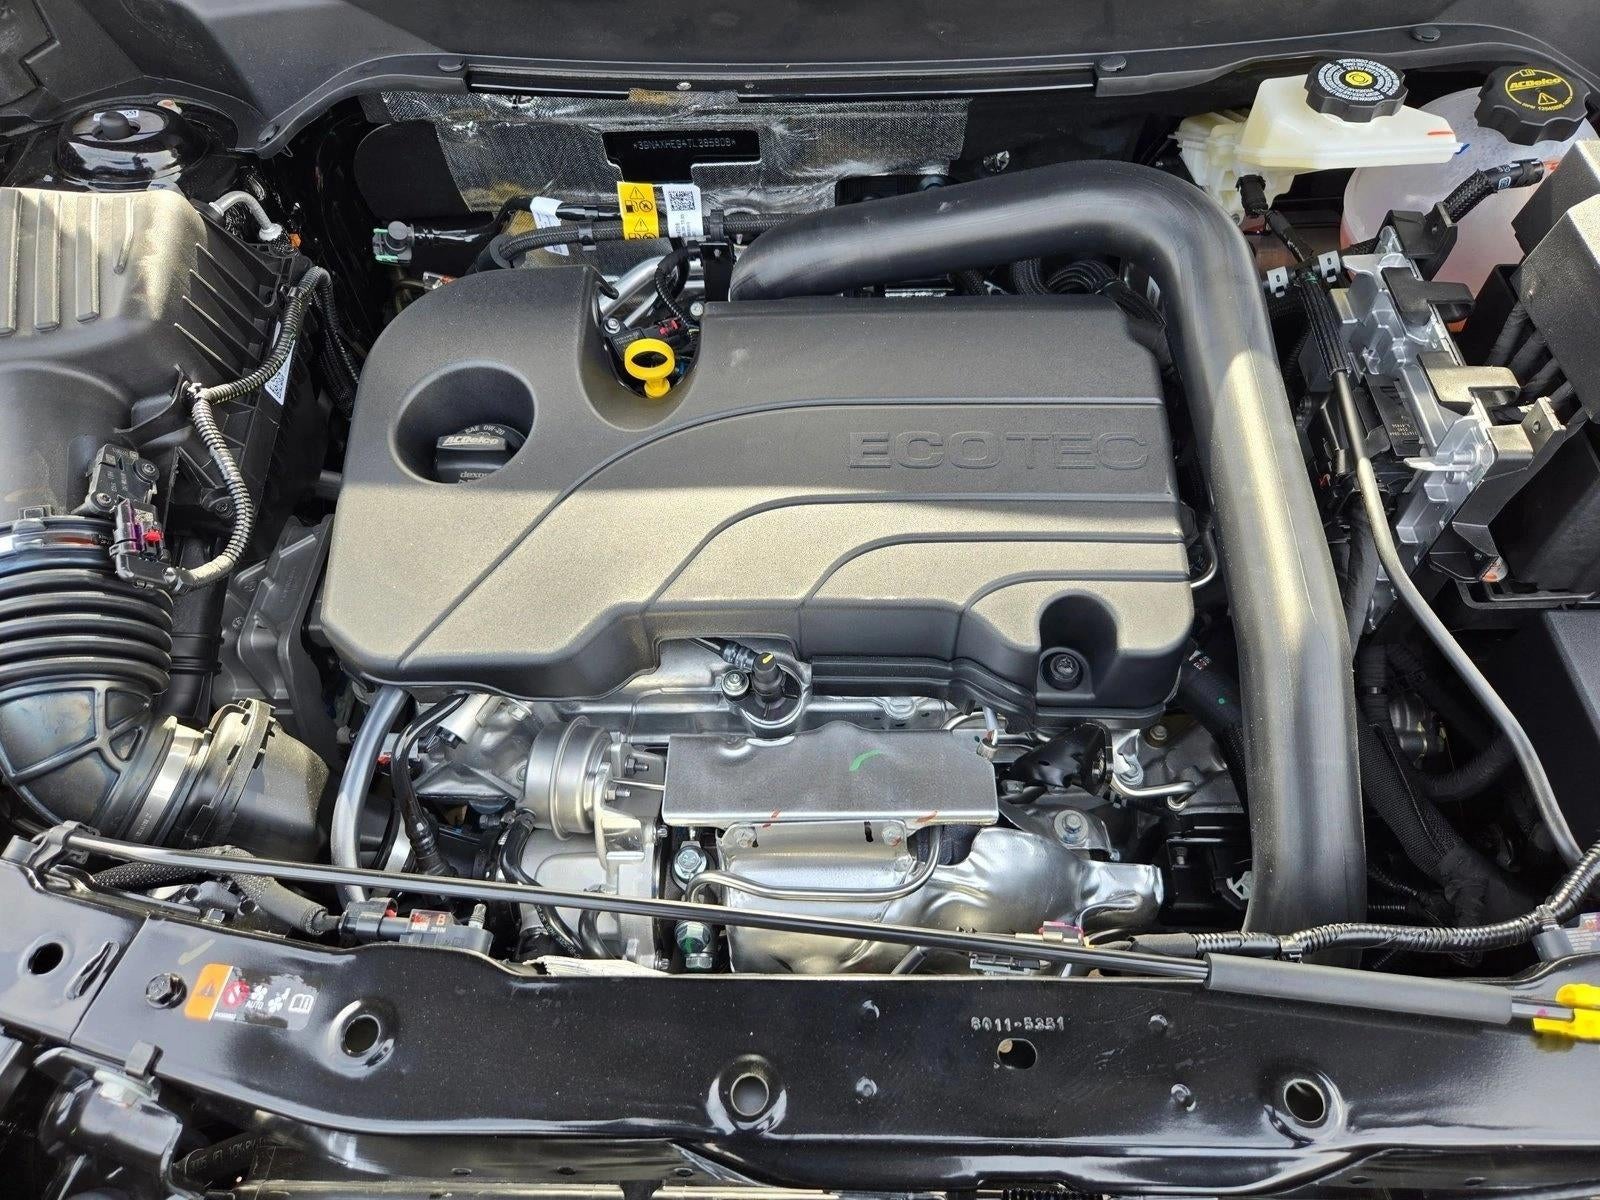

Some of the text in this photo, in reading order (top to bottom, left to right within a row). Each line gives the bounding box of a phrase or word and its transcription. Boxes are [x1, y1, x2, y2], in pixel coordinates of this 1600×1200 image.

[1509, 78, 1561, 89] ACDelco
[465, 425, 505, 435] SAE 0W-20
[442, 436, 499, 446] ACDelco
[848, 431, 1149, 469] ECOTEC
[245, 1000, 264, 1010] AUTO
